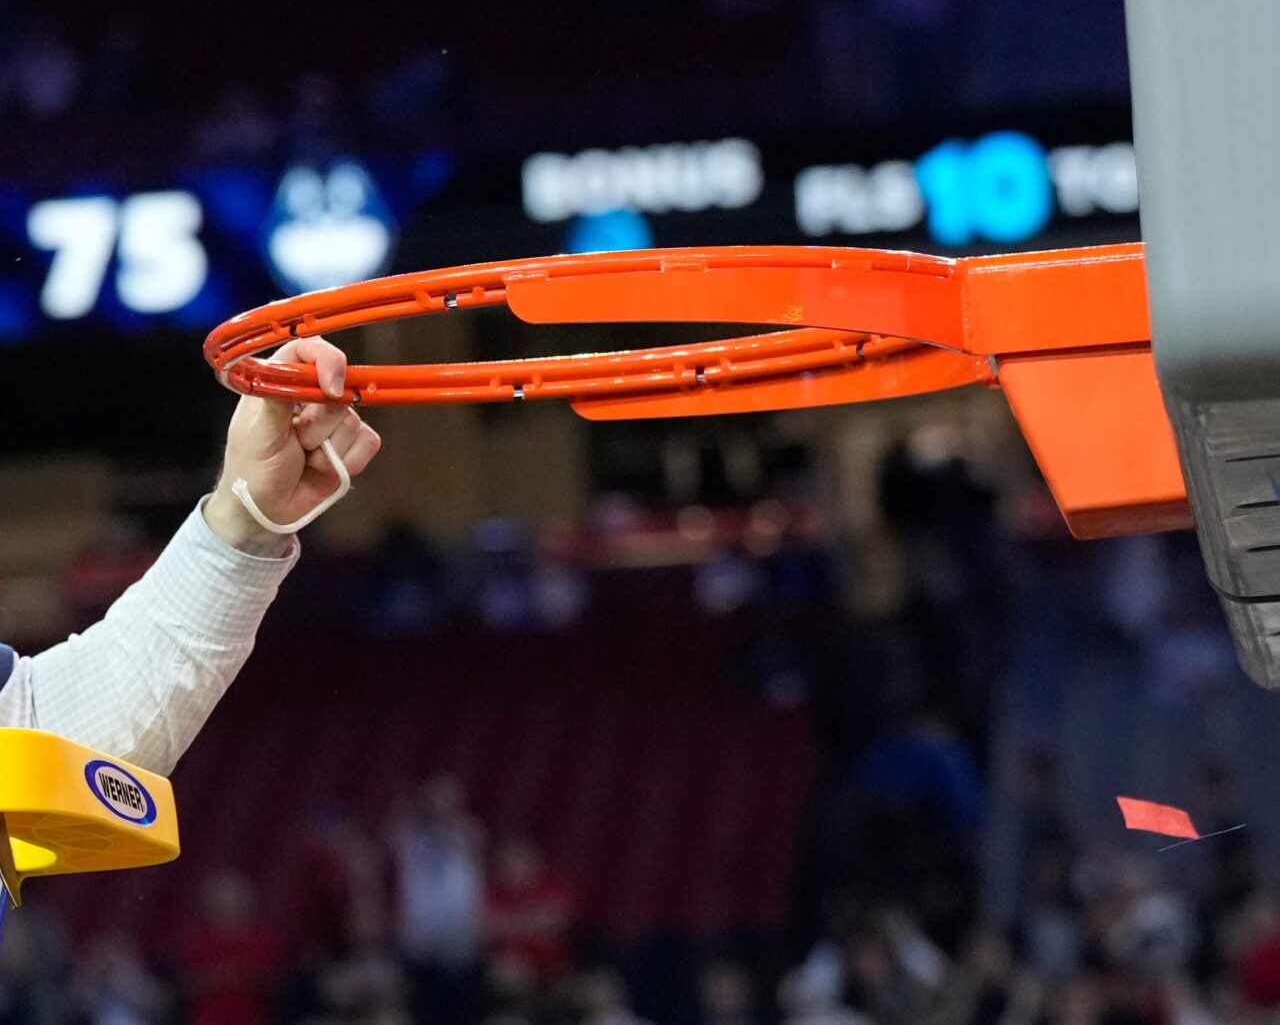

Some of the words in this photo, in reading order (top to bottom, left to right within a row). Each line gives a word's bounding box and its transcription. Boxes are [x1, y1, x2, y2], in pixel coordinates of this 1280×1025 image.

[522, 137, 762, 223] BONUS
[916, 130, 1051, 245] 10
[27, 190, 208, 320] 75
[98, 771, 145, 813] WERNER
